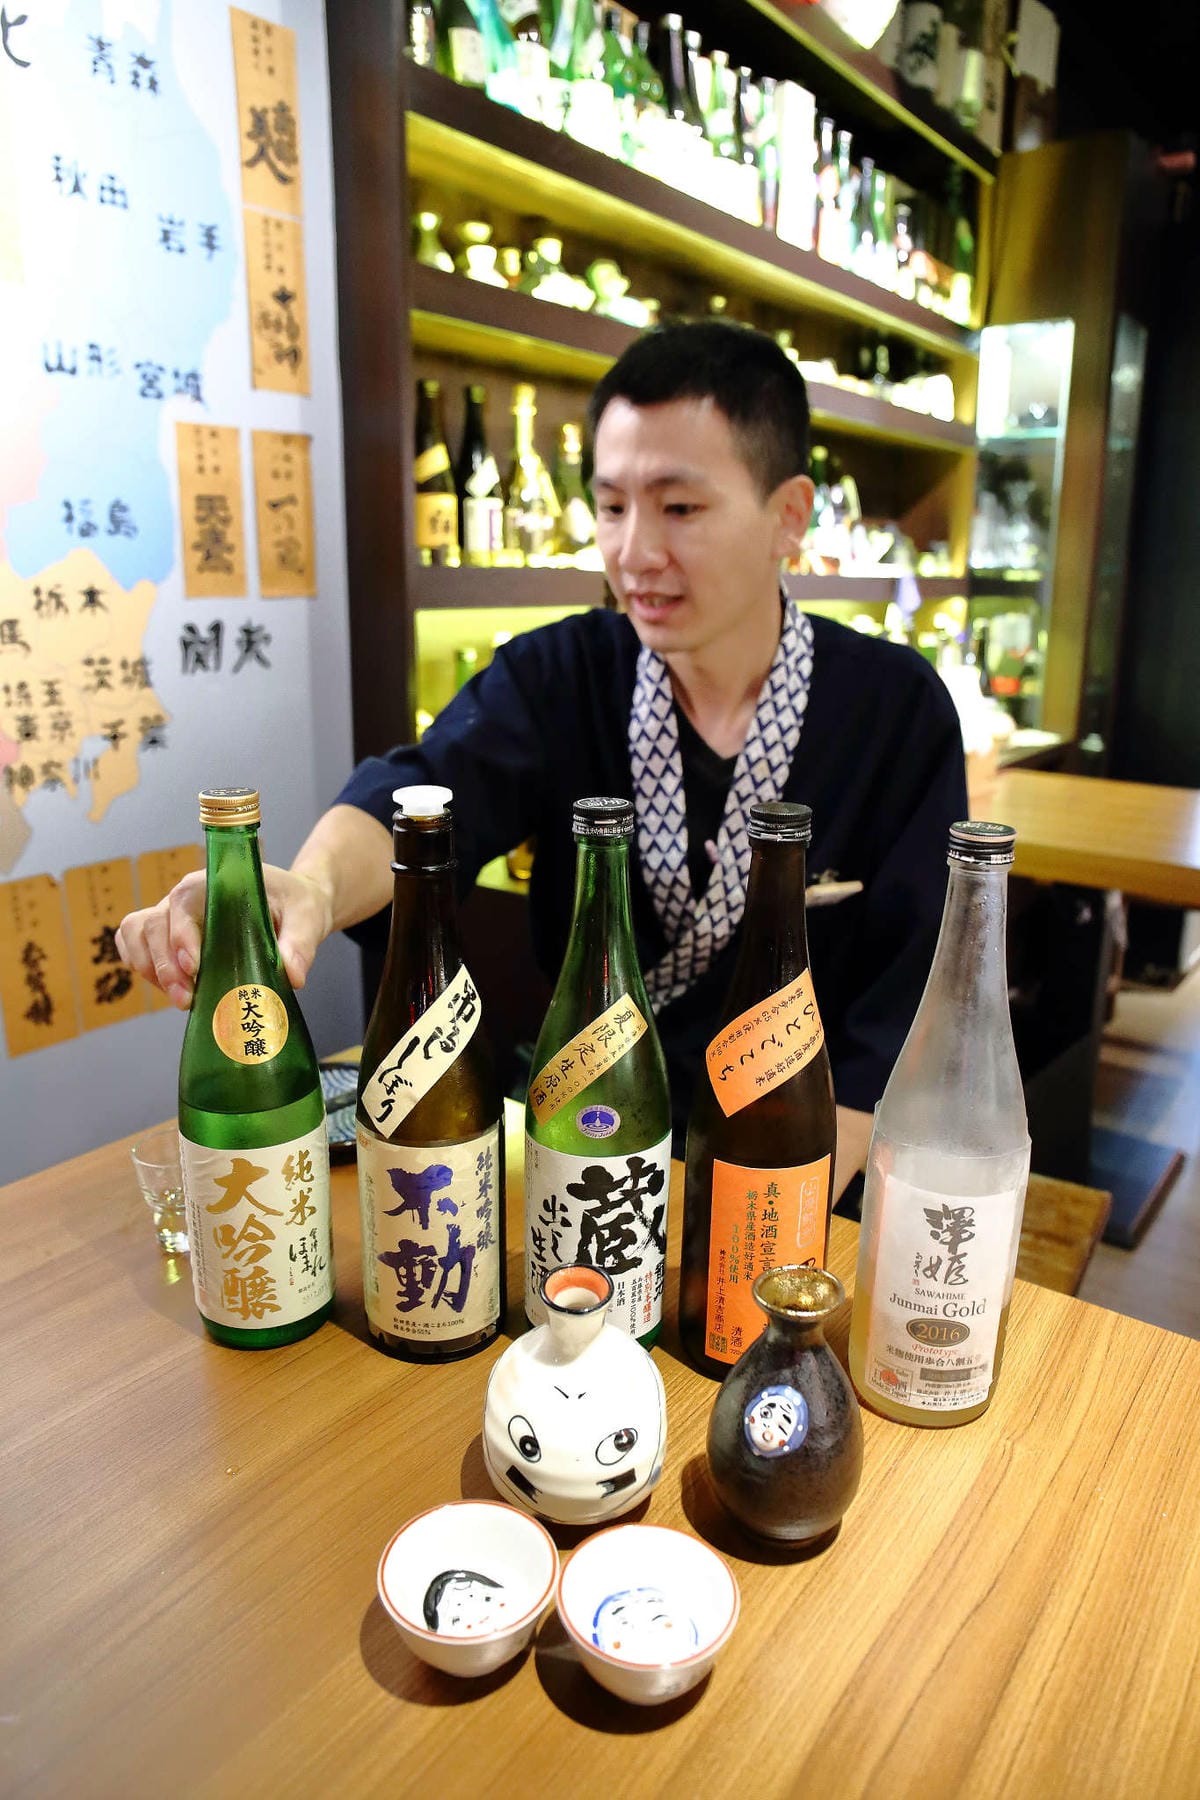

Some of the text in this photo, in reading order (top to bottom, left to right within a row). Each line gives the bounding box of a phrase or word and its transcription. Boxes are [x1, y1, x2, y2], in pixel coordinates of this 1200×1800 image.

[43, 340, 122, 376] 山形
[62, 497, 137, 538] 福島
[33, 584, 108, 618] 栃木
[82, 656, 152, 692] 茨城
[15, 711, 74, 744] 東京
[102, 714, 168, 751] 千葉
[238, 988, 262, 1001] 純米
[241, 1001, 269, 1057] 大吟醸
[533, 1006, 636, 1106] 夏限定生原酒
[281, 1150, 317, 1226] 純米
[475, 1146, 497, 1252] 純米吟醸
[205, 1157, 285, 1320] 大吟醸
[377, 1164, 477, 1314] 不動
[616, 1281, 625, 1307] 日本酒
[889, 1293, 987, 1318] Junmai Gold
[914, 1287, 966, 1301] SAWAHIME
[730, 1325, 744, 1348] 清酒
[916, 1323, 961, 1341] 2016
